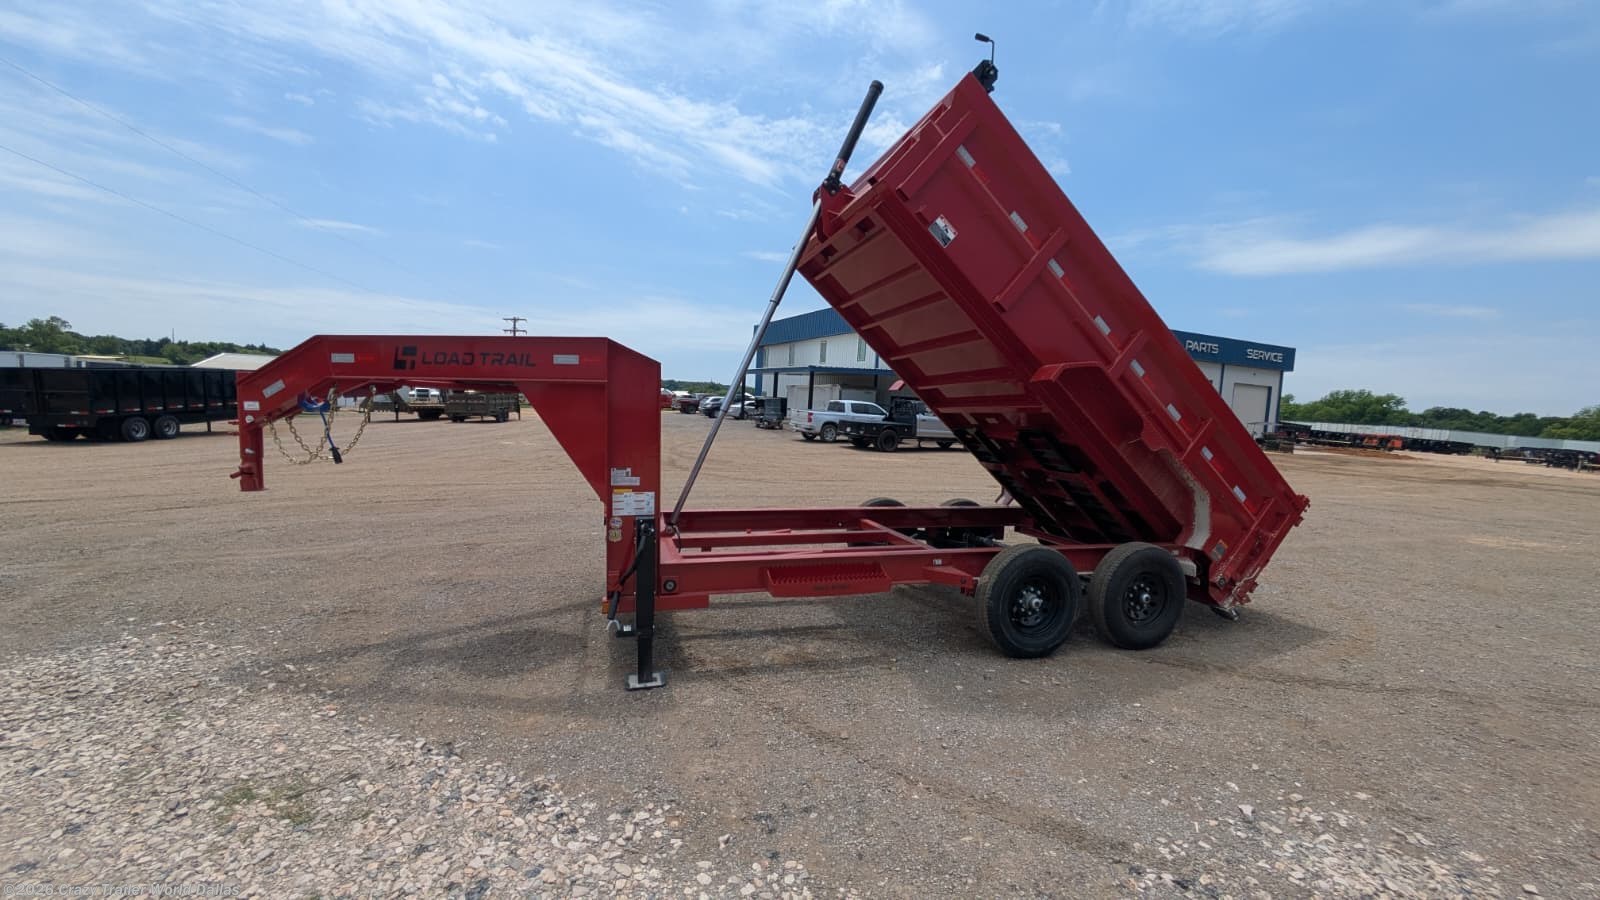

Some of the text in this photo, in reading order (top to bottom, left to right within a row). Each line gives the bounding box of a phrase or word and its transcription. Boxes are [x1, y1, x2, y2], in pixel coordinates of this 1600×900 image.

[1185, 340, 1219, 354] PARTS
[421, 352, 536, 367] LOAD TRAIL
[1247, 348, 1283, 363] SERVICE
